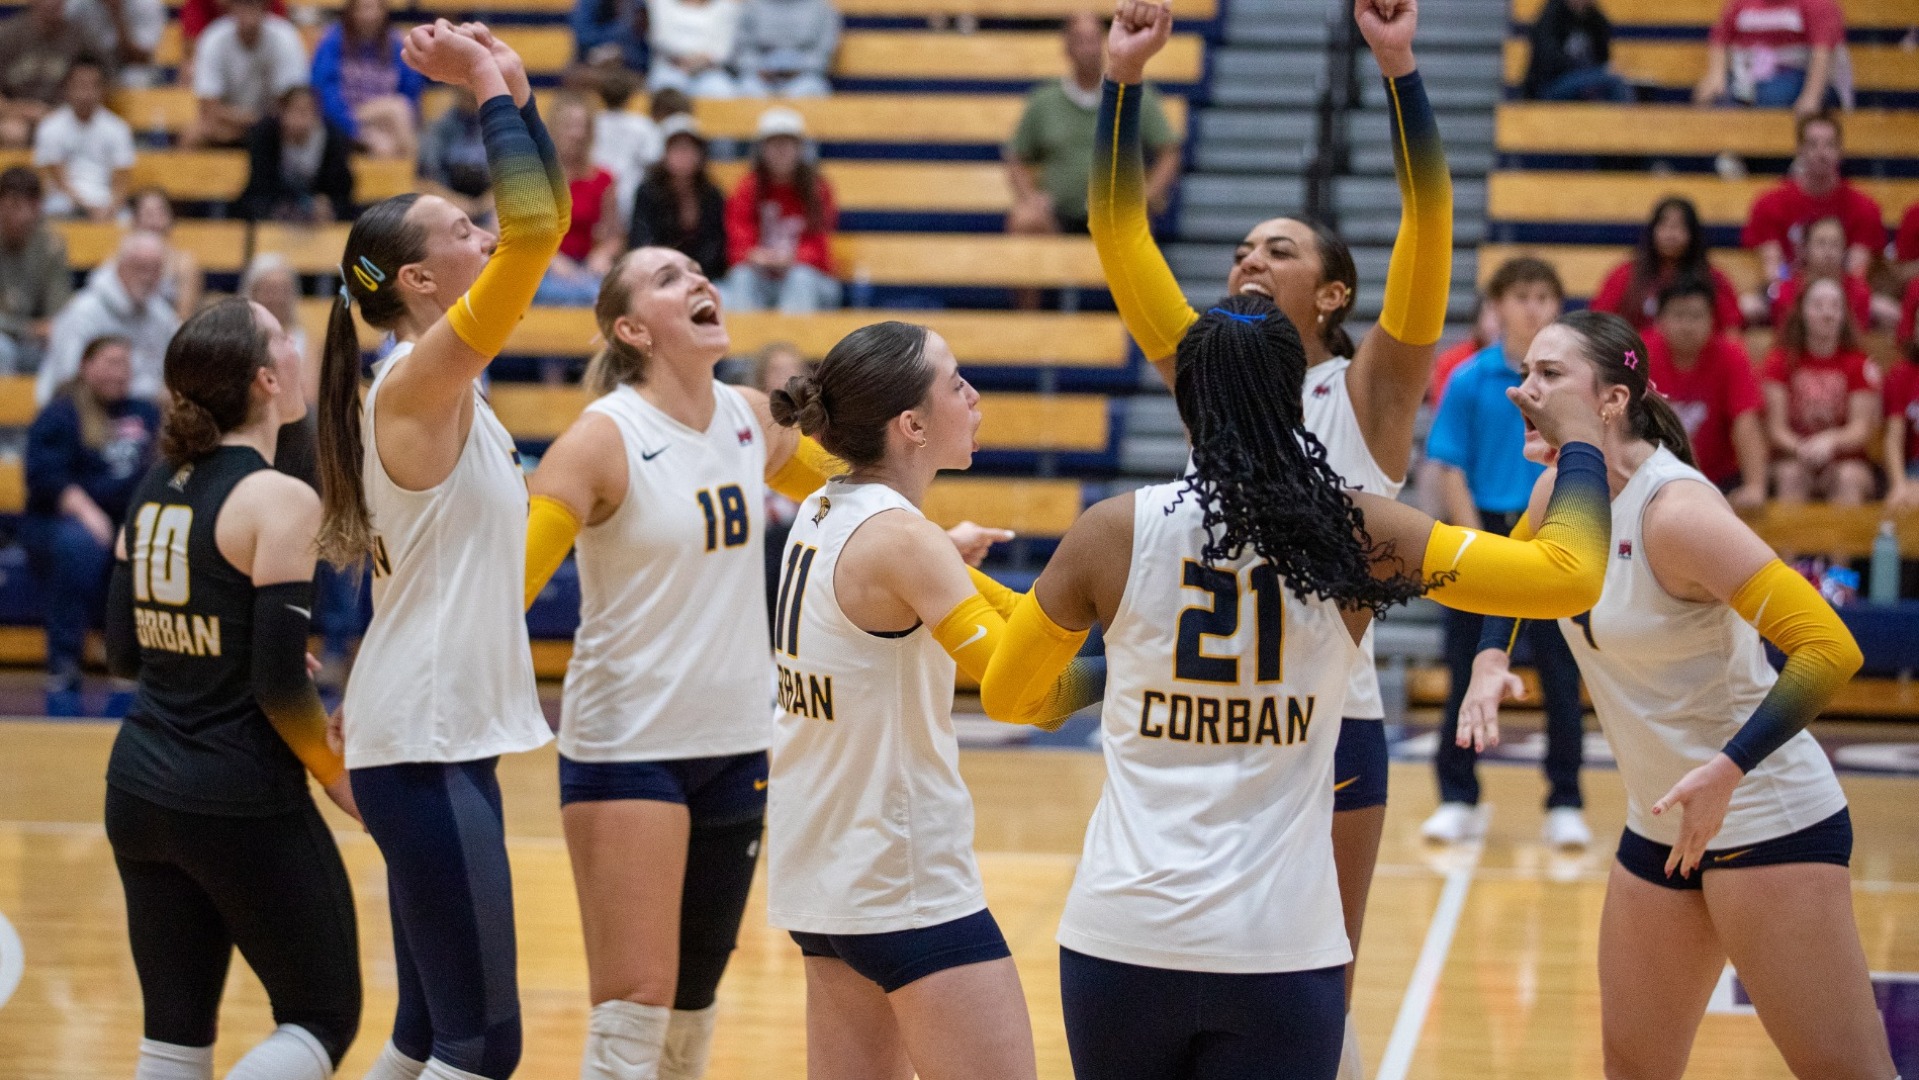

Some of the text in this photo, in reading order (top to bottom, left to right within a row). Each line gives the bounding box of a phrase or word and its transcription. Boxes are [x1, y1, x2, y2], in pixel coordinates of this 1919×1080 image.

[696, 485, 749, 553] 18
[134, 502, 193, 606] 10
[134, 607, 222, 656] ORBAN
[775, 541, 818, 659] 11
[1172, 557, 1286, 686] 21
[777, 662, 835, 722] RBAN
[1139, 689, 1316, 746] CORBAN
